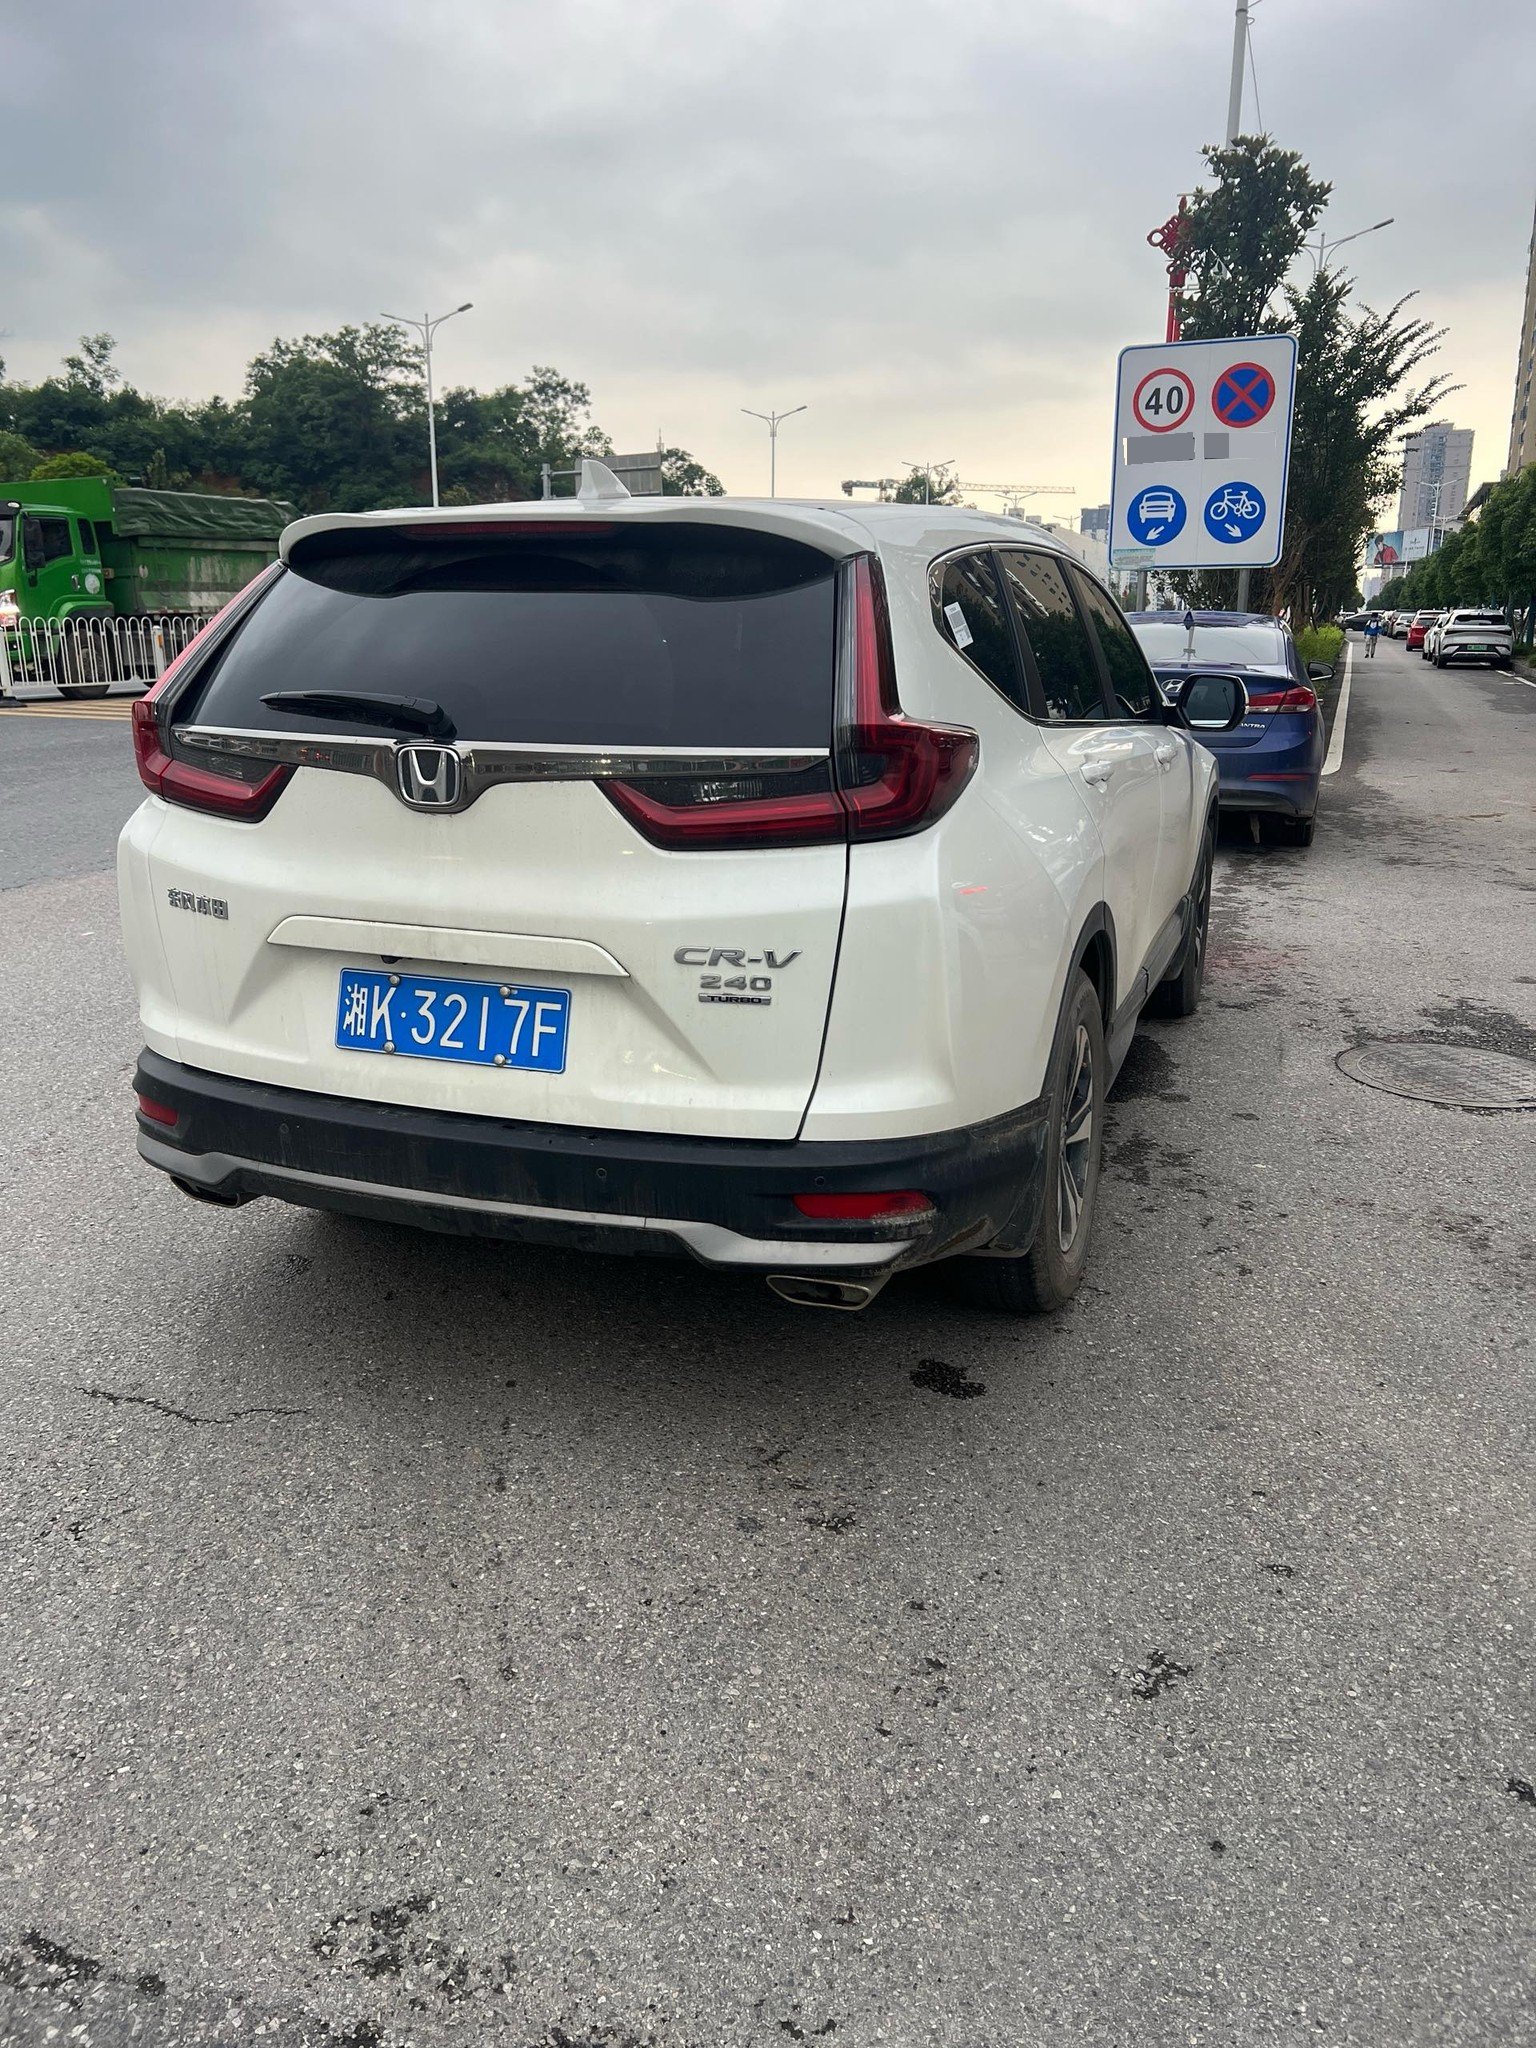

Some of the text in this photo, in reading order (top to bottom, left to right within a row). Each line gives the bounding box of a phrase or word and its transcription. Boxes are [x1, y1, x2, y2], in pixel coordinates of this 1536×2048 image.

[1145, 386, 1183, 415] 40
[167, 887, 229, 920] 东风本田
[673, 945, 803, 969] CR-V
[700, 973, 772, 992] 240
[707, 995, 762, 1004] TURBO
